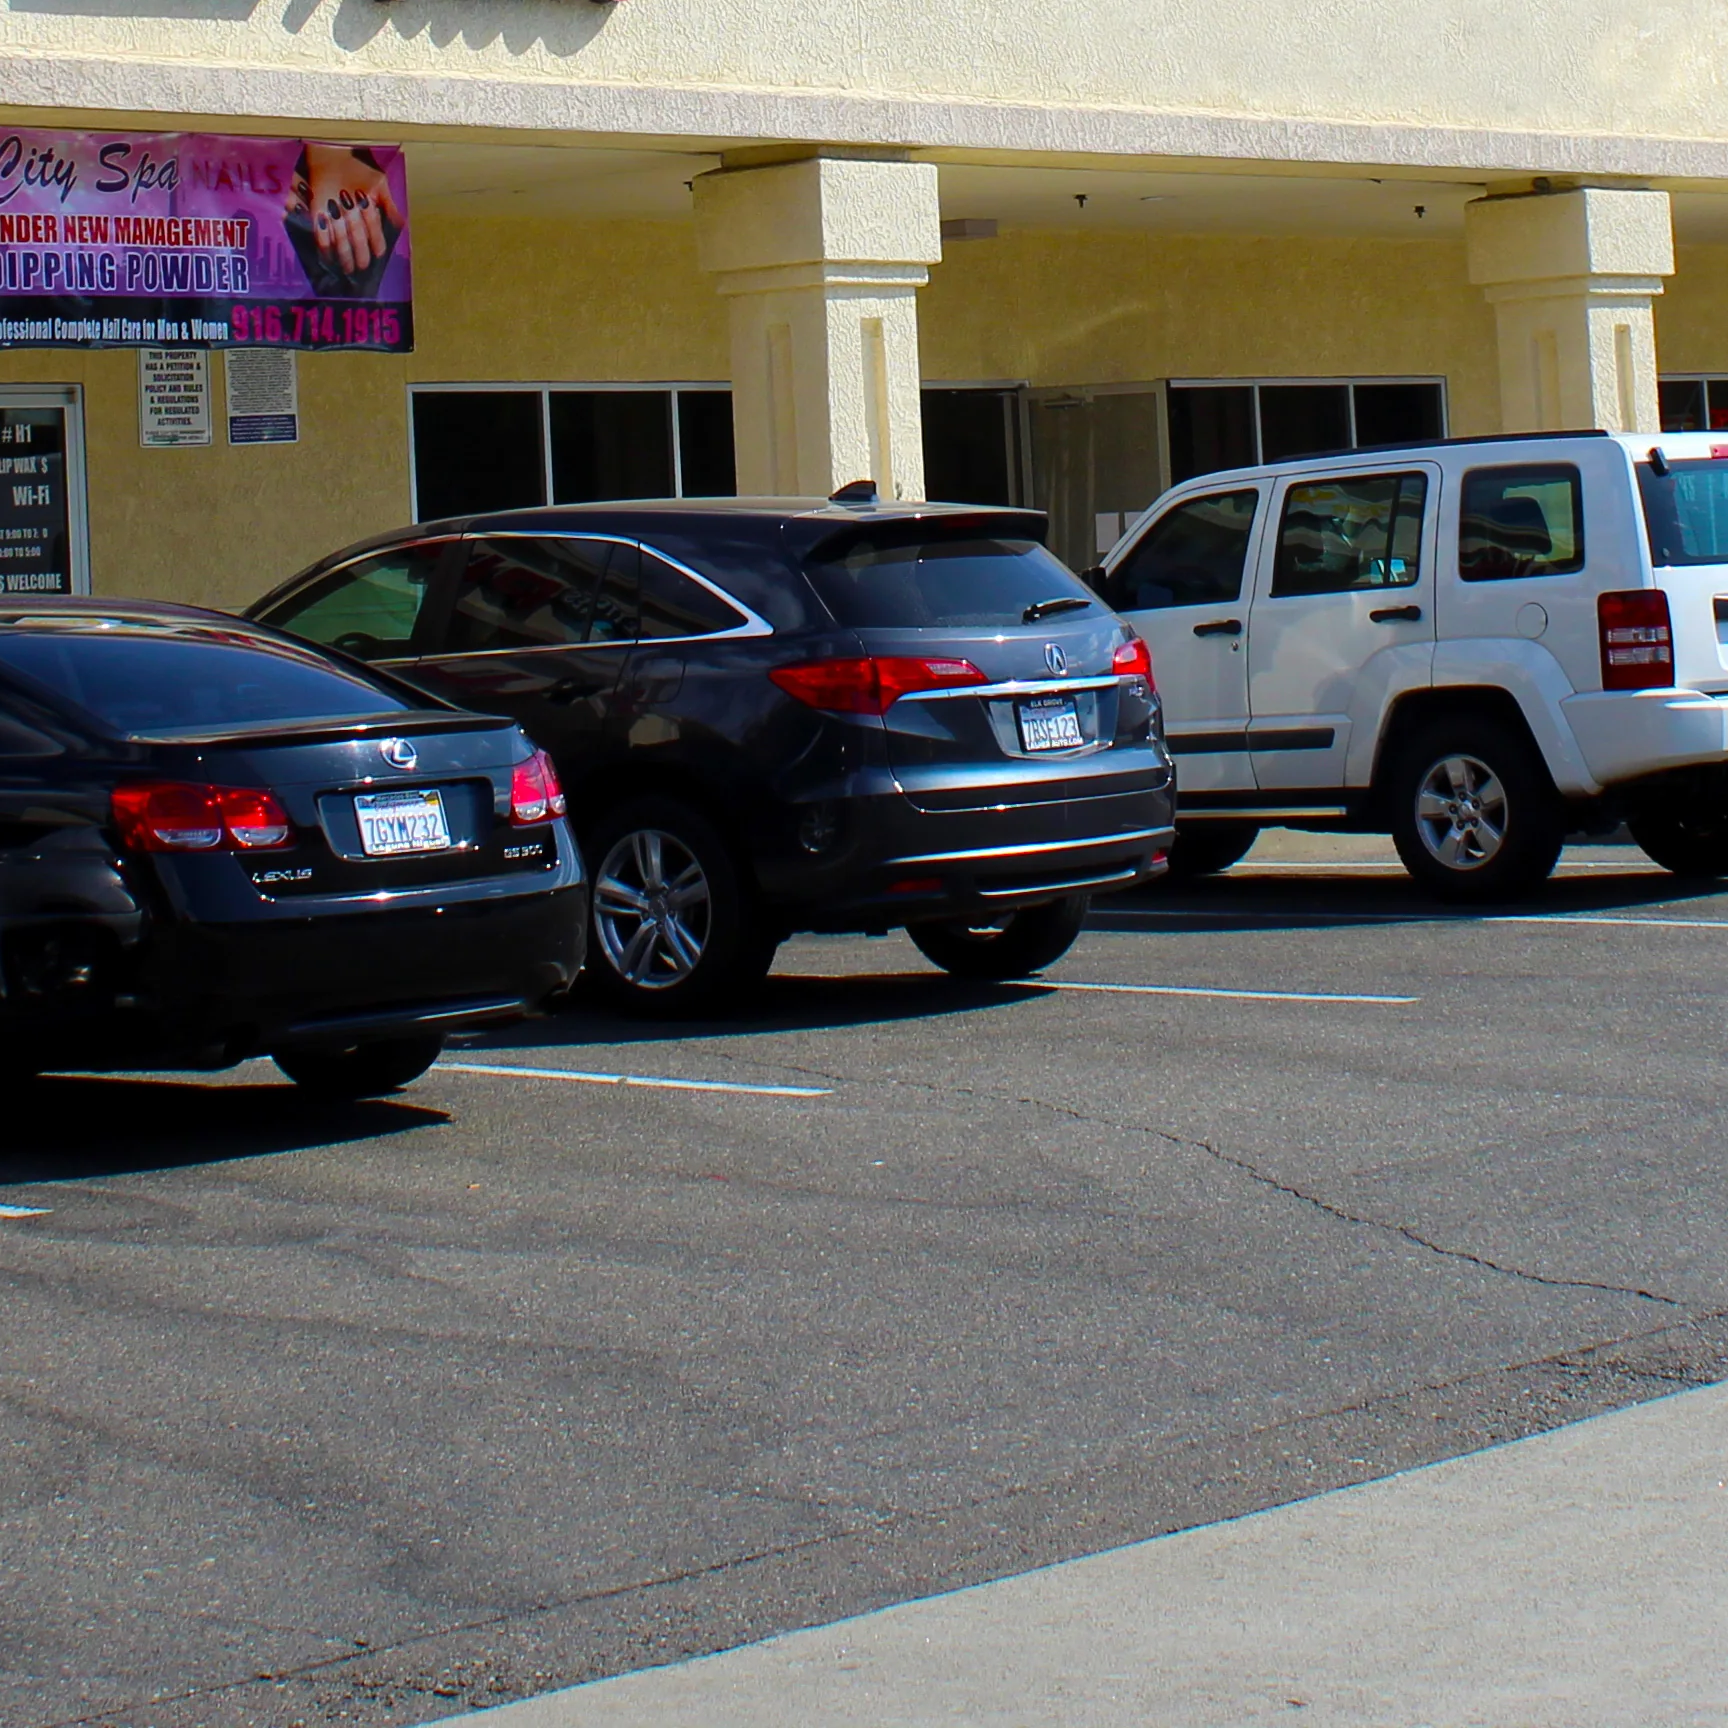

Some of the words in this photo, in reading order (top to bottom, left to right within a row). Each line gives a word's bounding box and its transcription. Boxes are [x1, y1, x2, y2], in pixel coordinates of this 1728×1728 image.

[96, 142, 181, 204] Spa
[190, 160, 283, 194] NAILS
[63, 215, 109, 246] NEW
[114, 216, 250, 249] MANAGEMENT
[127, 252, 249, 293] POWDER
[54, 318, 100, 342] Complete
[103, 318, 120, 340] Nail
[122, 319, 141, 340] Care
[143, 318, 155, 340] for
[157, 319, 178, 340] Men
[181, 320, 189, 340] &
[191, 319, 229, 340] Women
[231, 304, 401, 344] 916.714.1915
[1, 426, 12, 442] #
[15, 424, 32, 443] H1
[13, 457, 37, 473] WAX
[13, 485, 50, 506] Wi-Fi
[7, 573, 62, 591] WELCOME
[363, 813, 442, 845] 7GYM232
[252, 869, 312, 883] LEXUS
